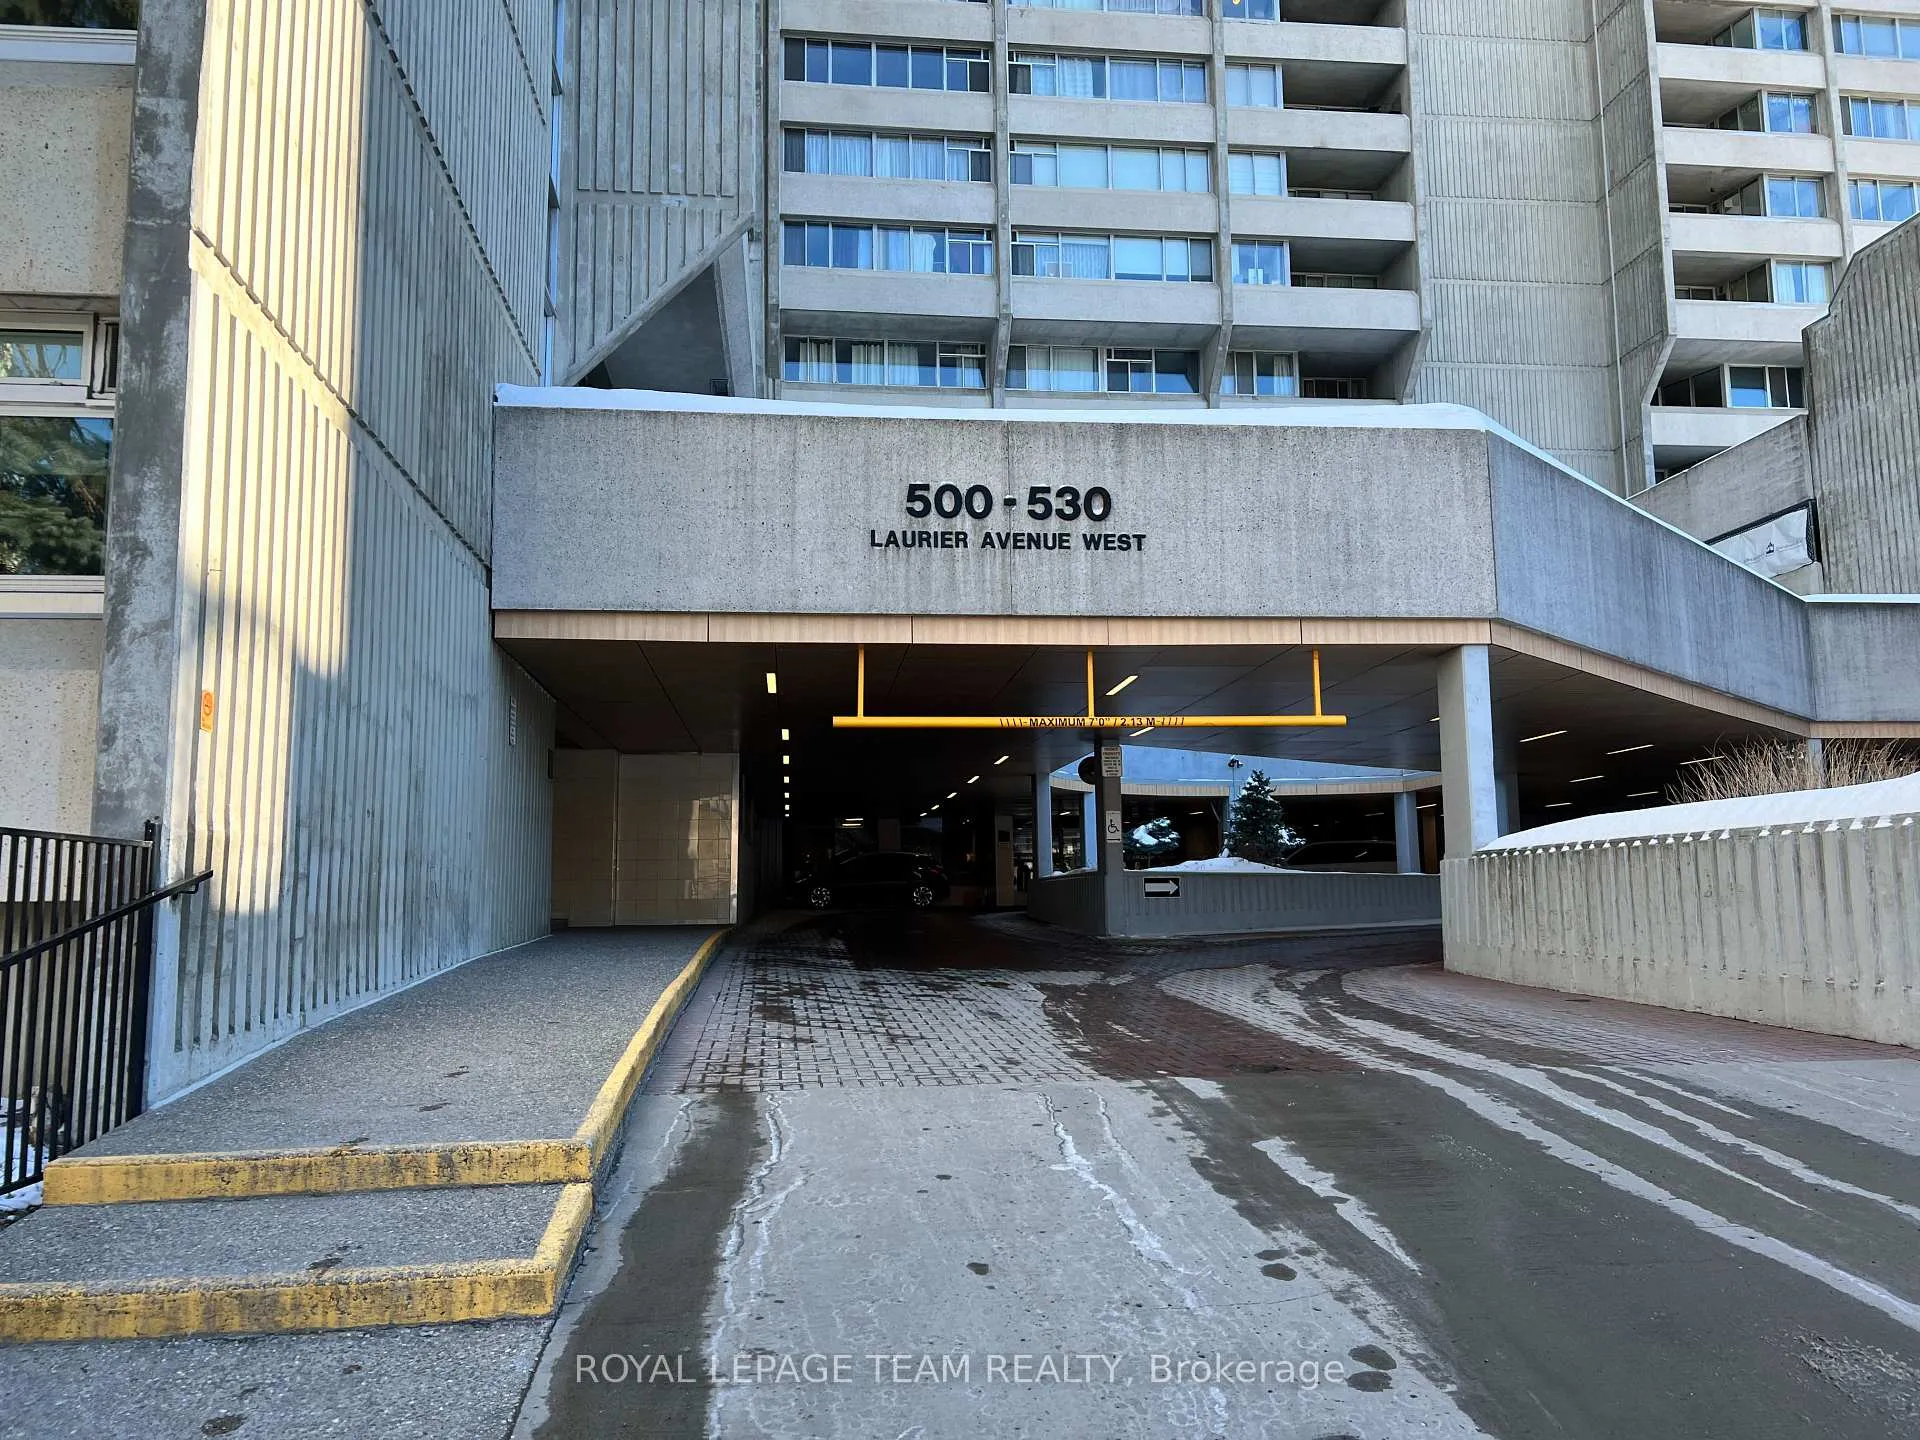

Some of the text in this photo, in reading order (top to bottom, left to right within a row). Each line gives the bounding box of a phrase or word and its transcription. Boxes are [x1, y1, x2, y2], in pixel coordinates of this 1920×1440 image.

[870, 530, 1146, 551] LAURIER AVENUE WEST
[1030, 717, 1085, 727] MAXIMUM
[1120, 717, 1143, 727] 2.13
